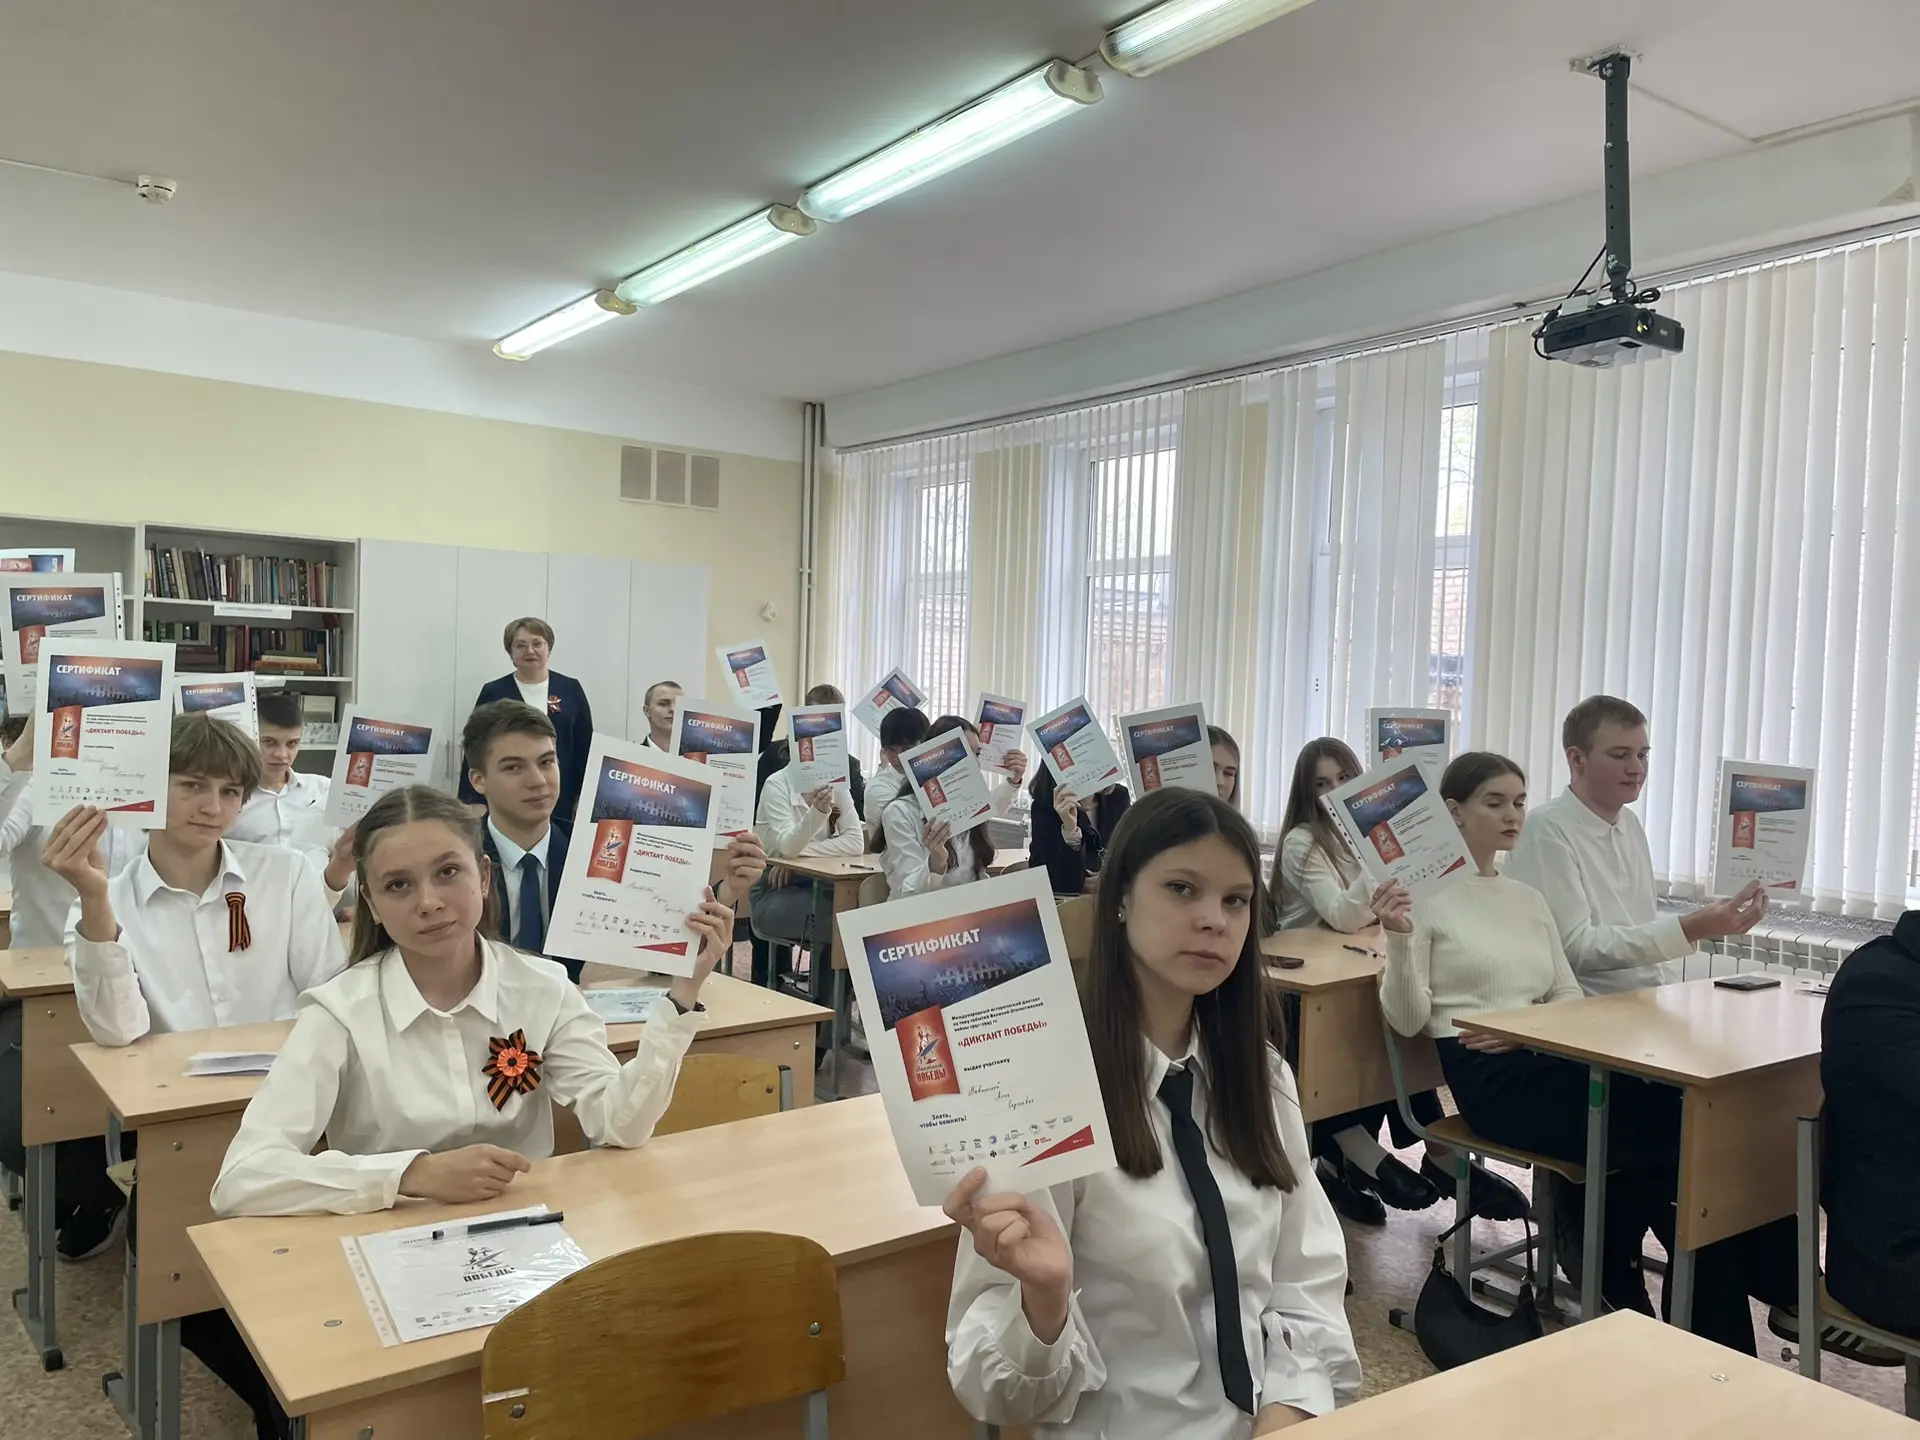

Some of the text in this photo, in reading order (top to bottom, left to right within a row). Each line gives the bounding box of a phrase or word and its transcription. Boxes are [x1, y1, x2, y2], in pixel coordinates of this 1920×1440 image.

[17, 594, 73, 602] СЕРТИФИКАТ
[56, 665, 122, 676] СЕРТИФИКАТ
[357, 724, 405, 736] СЕРТИФИКАТ
[688, 719, 733, 732] СЕРТИФИКАТ
[608, 769, 676, 795] СЕРТИФИКАТ
[1351, 783, 1396, 810] СЕРТИФИКАТ
[878, 928, 981, 964] СЕРТИФИКАТ
[957, 1020, 1048, 1048] «ДИКТАНТ ПОБЕДЫ»
[916, 1068, 947, 1082] ПОБЕДЫ
[919, 1120, 938, 1129] чтобы
